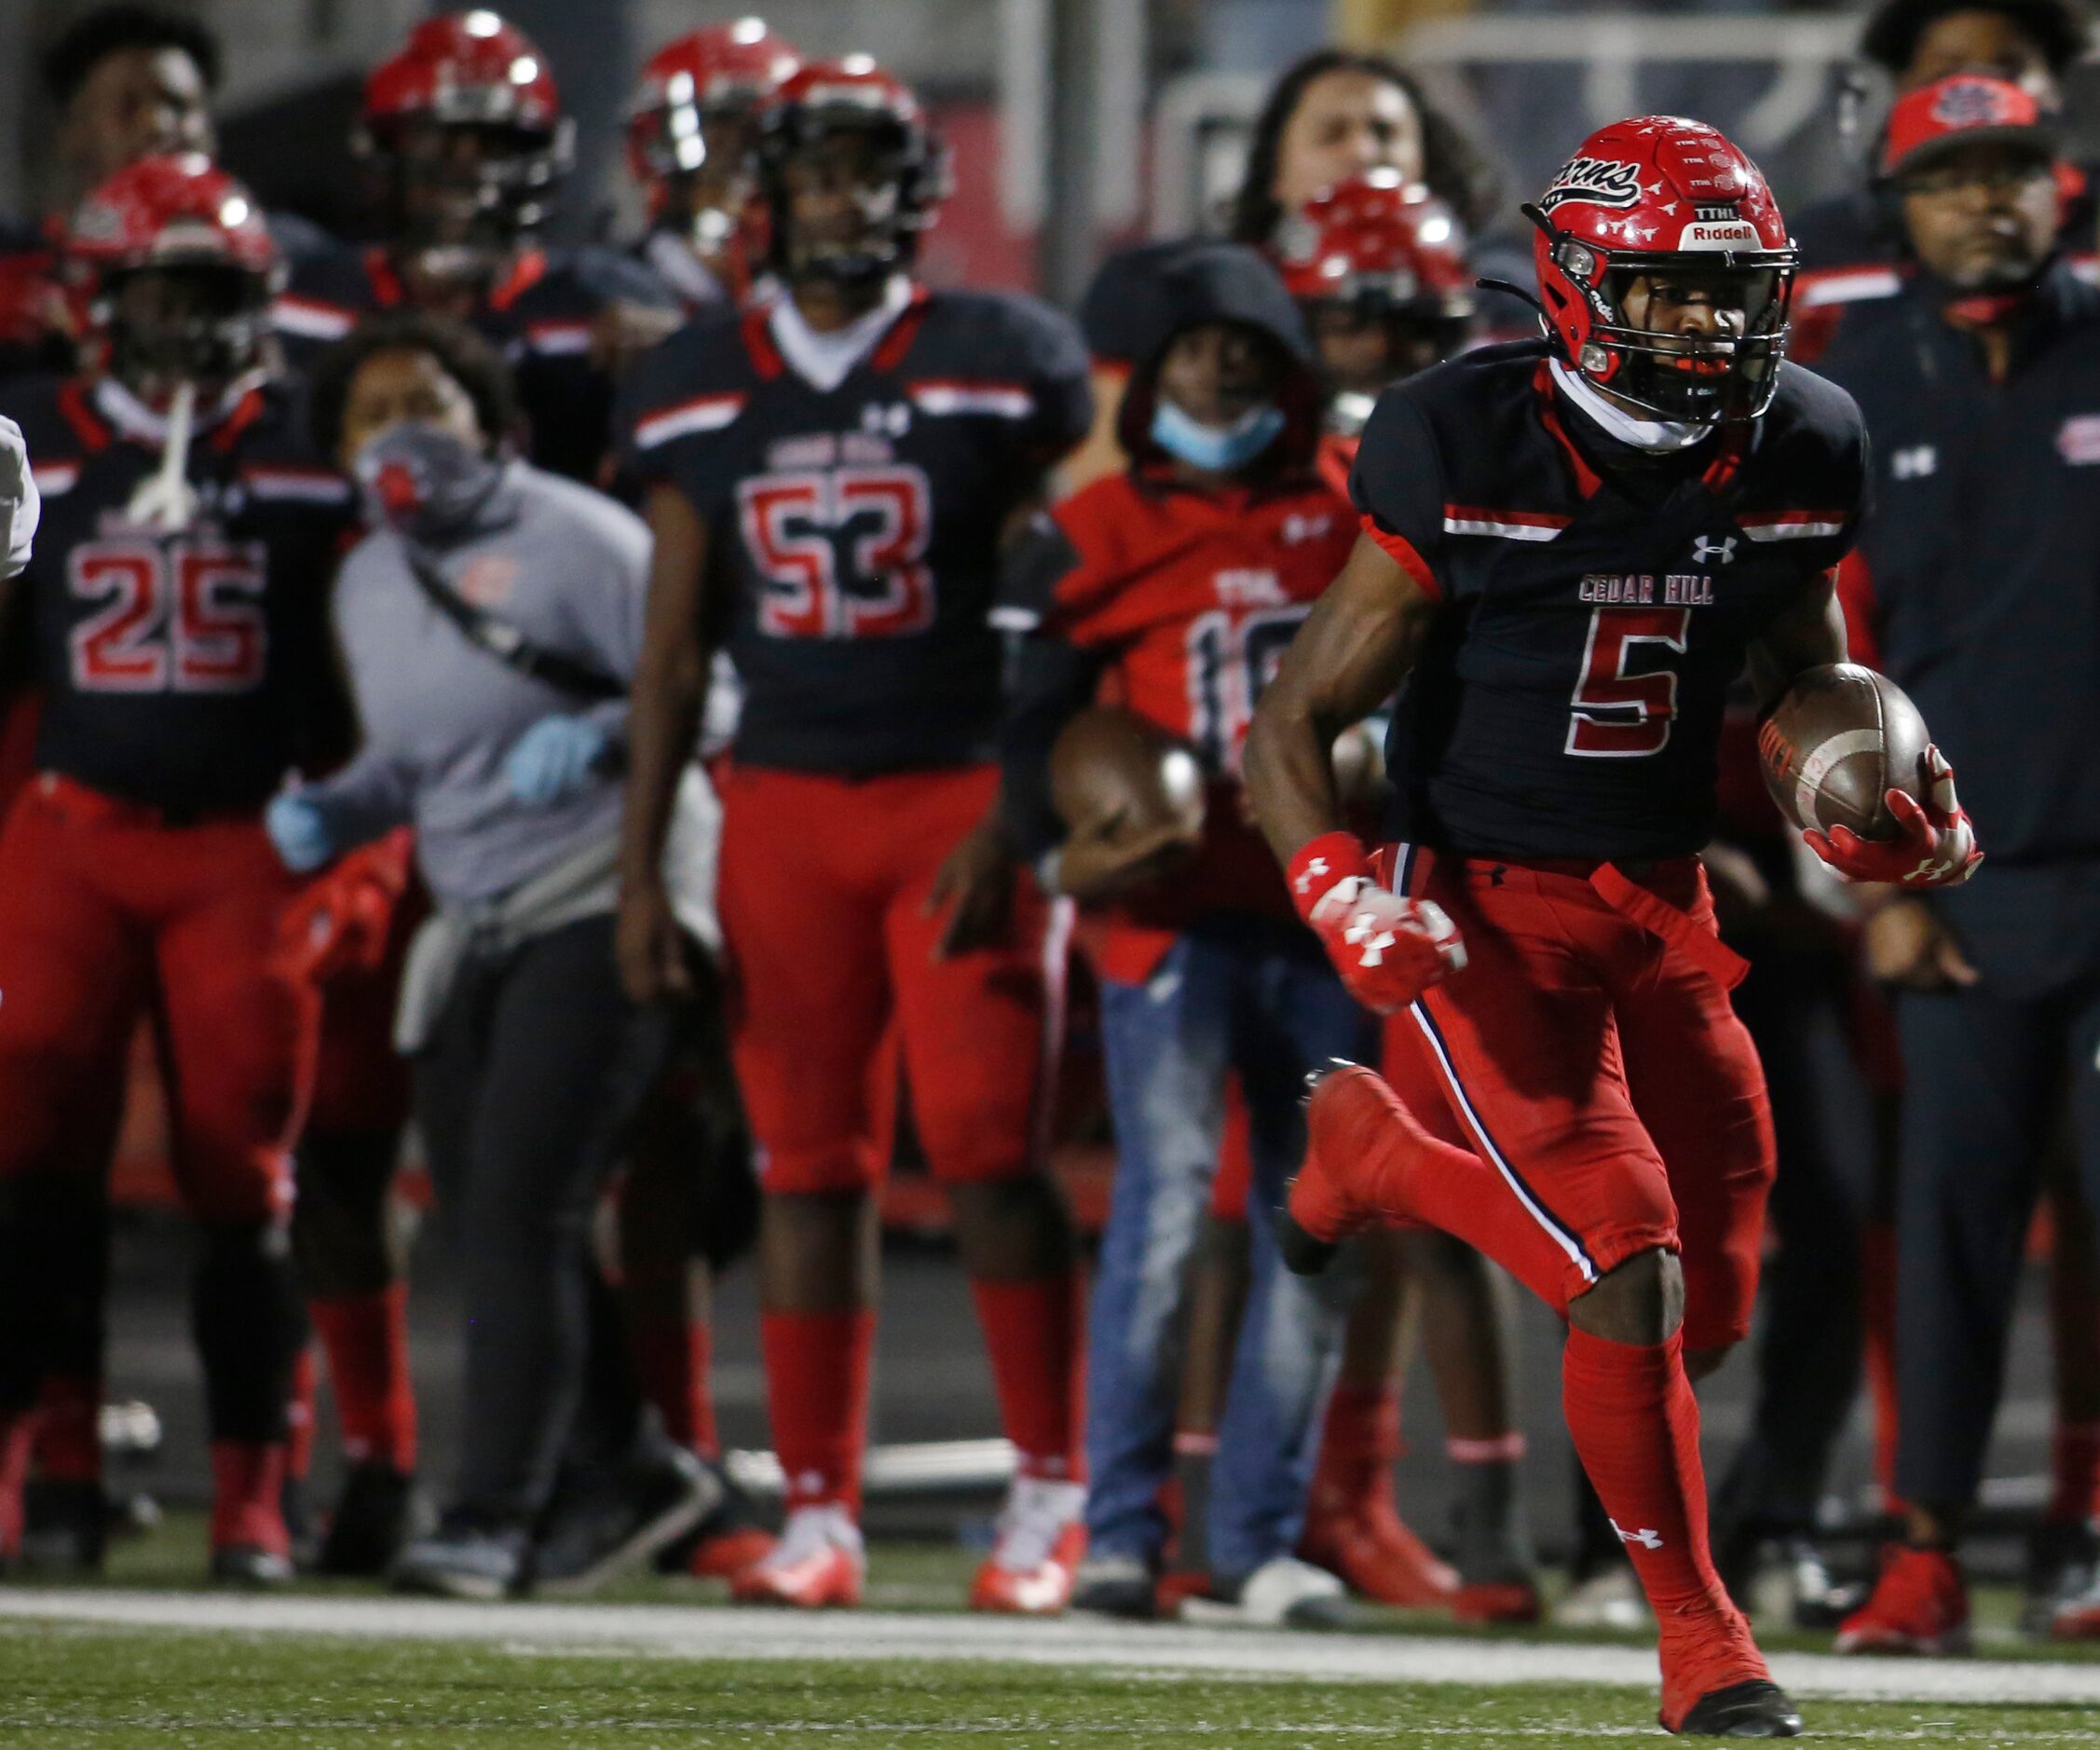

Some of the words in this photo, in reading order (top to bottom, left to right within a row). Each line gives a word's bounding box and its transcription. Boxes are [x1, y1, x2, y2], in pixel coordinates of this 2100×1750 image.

[1693, 226, 1752, 240] Riddell
[1695, 207, 1738, 220] TTHL
[735, 465, 935, 639] 53
[1578, 573, 1655, 604] CEDAR
[1664, 574, 1714, 606] HILL
[68, 540, 268, 693] 25
[1563, 606, 1692, 759] 5
